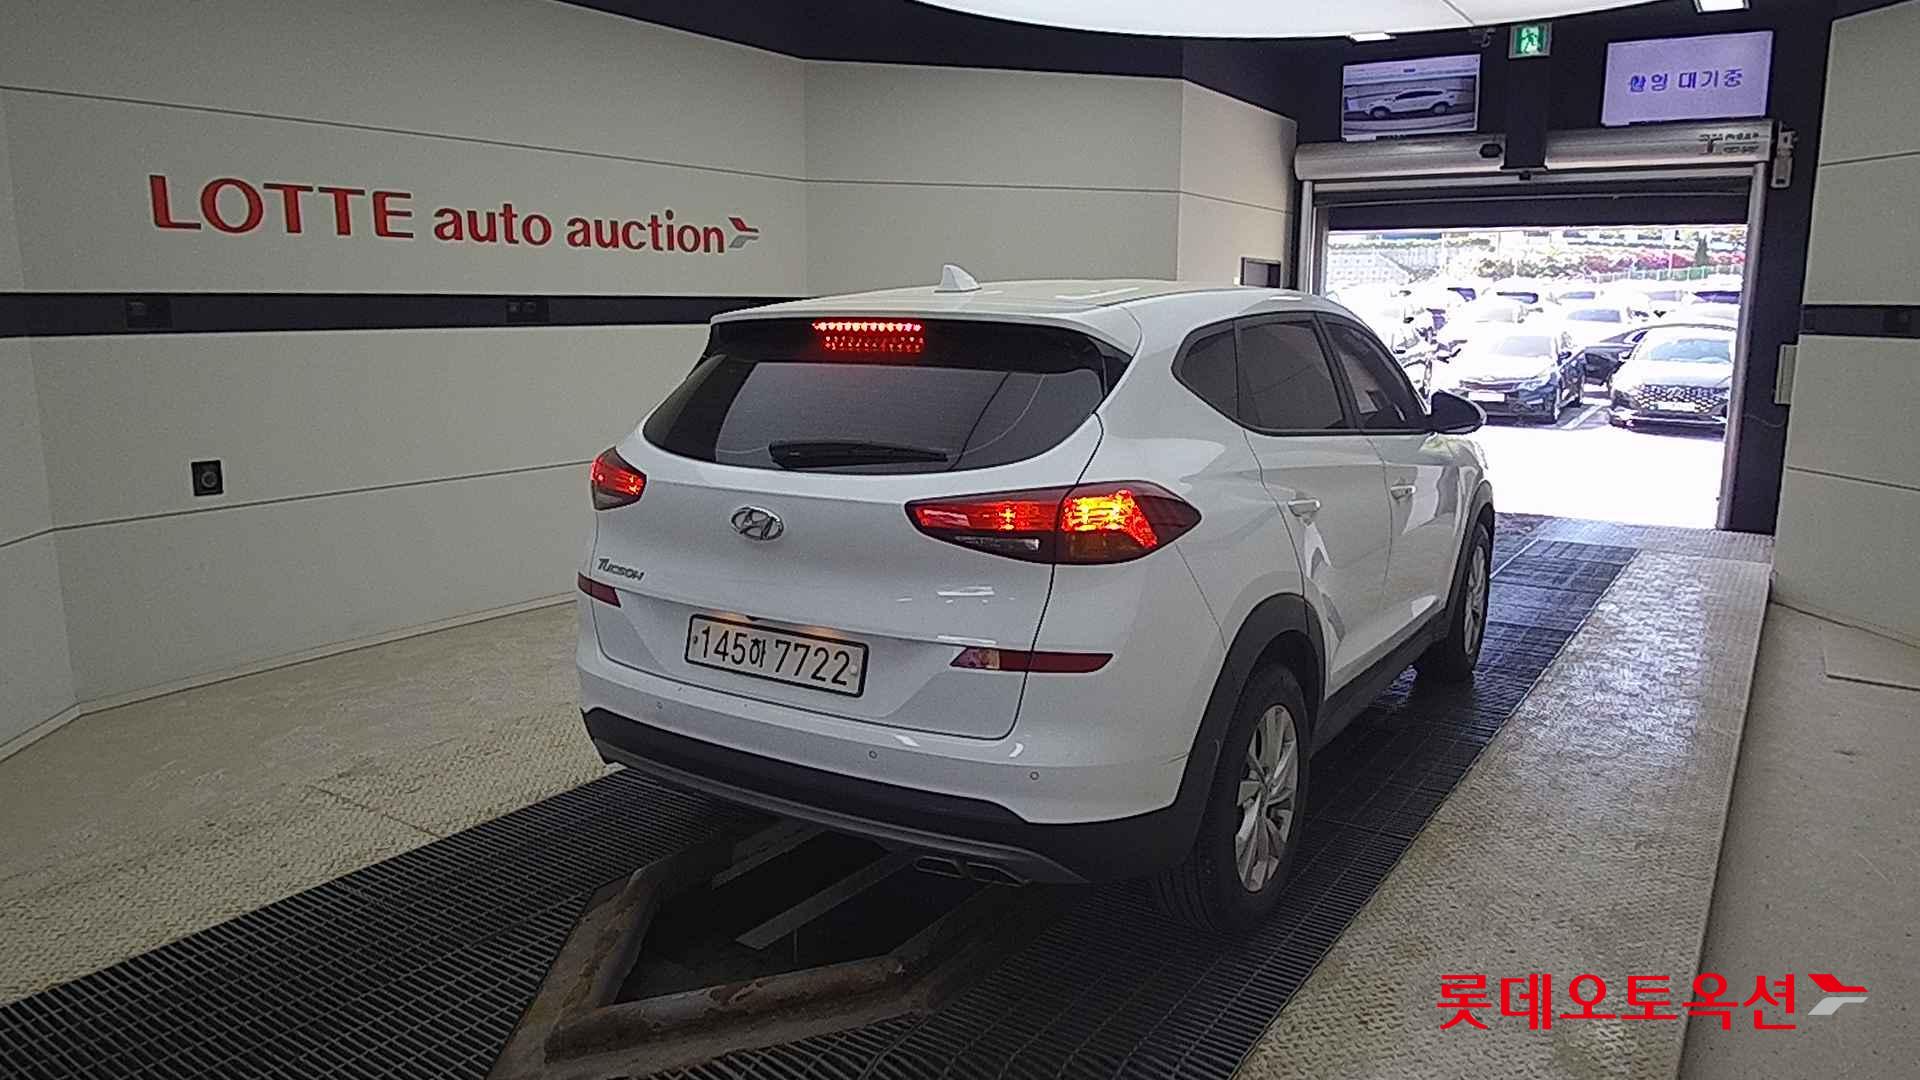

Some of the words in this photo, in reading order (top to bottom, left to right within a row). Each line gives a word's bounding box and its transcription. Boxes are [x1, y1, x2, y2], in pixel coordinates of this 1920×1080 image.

[1678, 68, 1743, 89] 대기중
[149, 175, 414, 239] LOTTE
[433, 203, 552, 247] auto
[566, 209, 725, 254] auction
